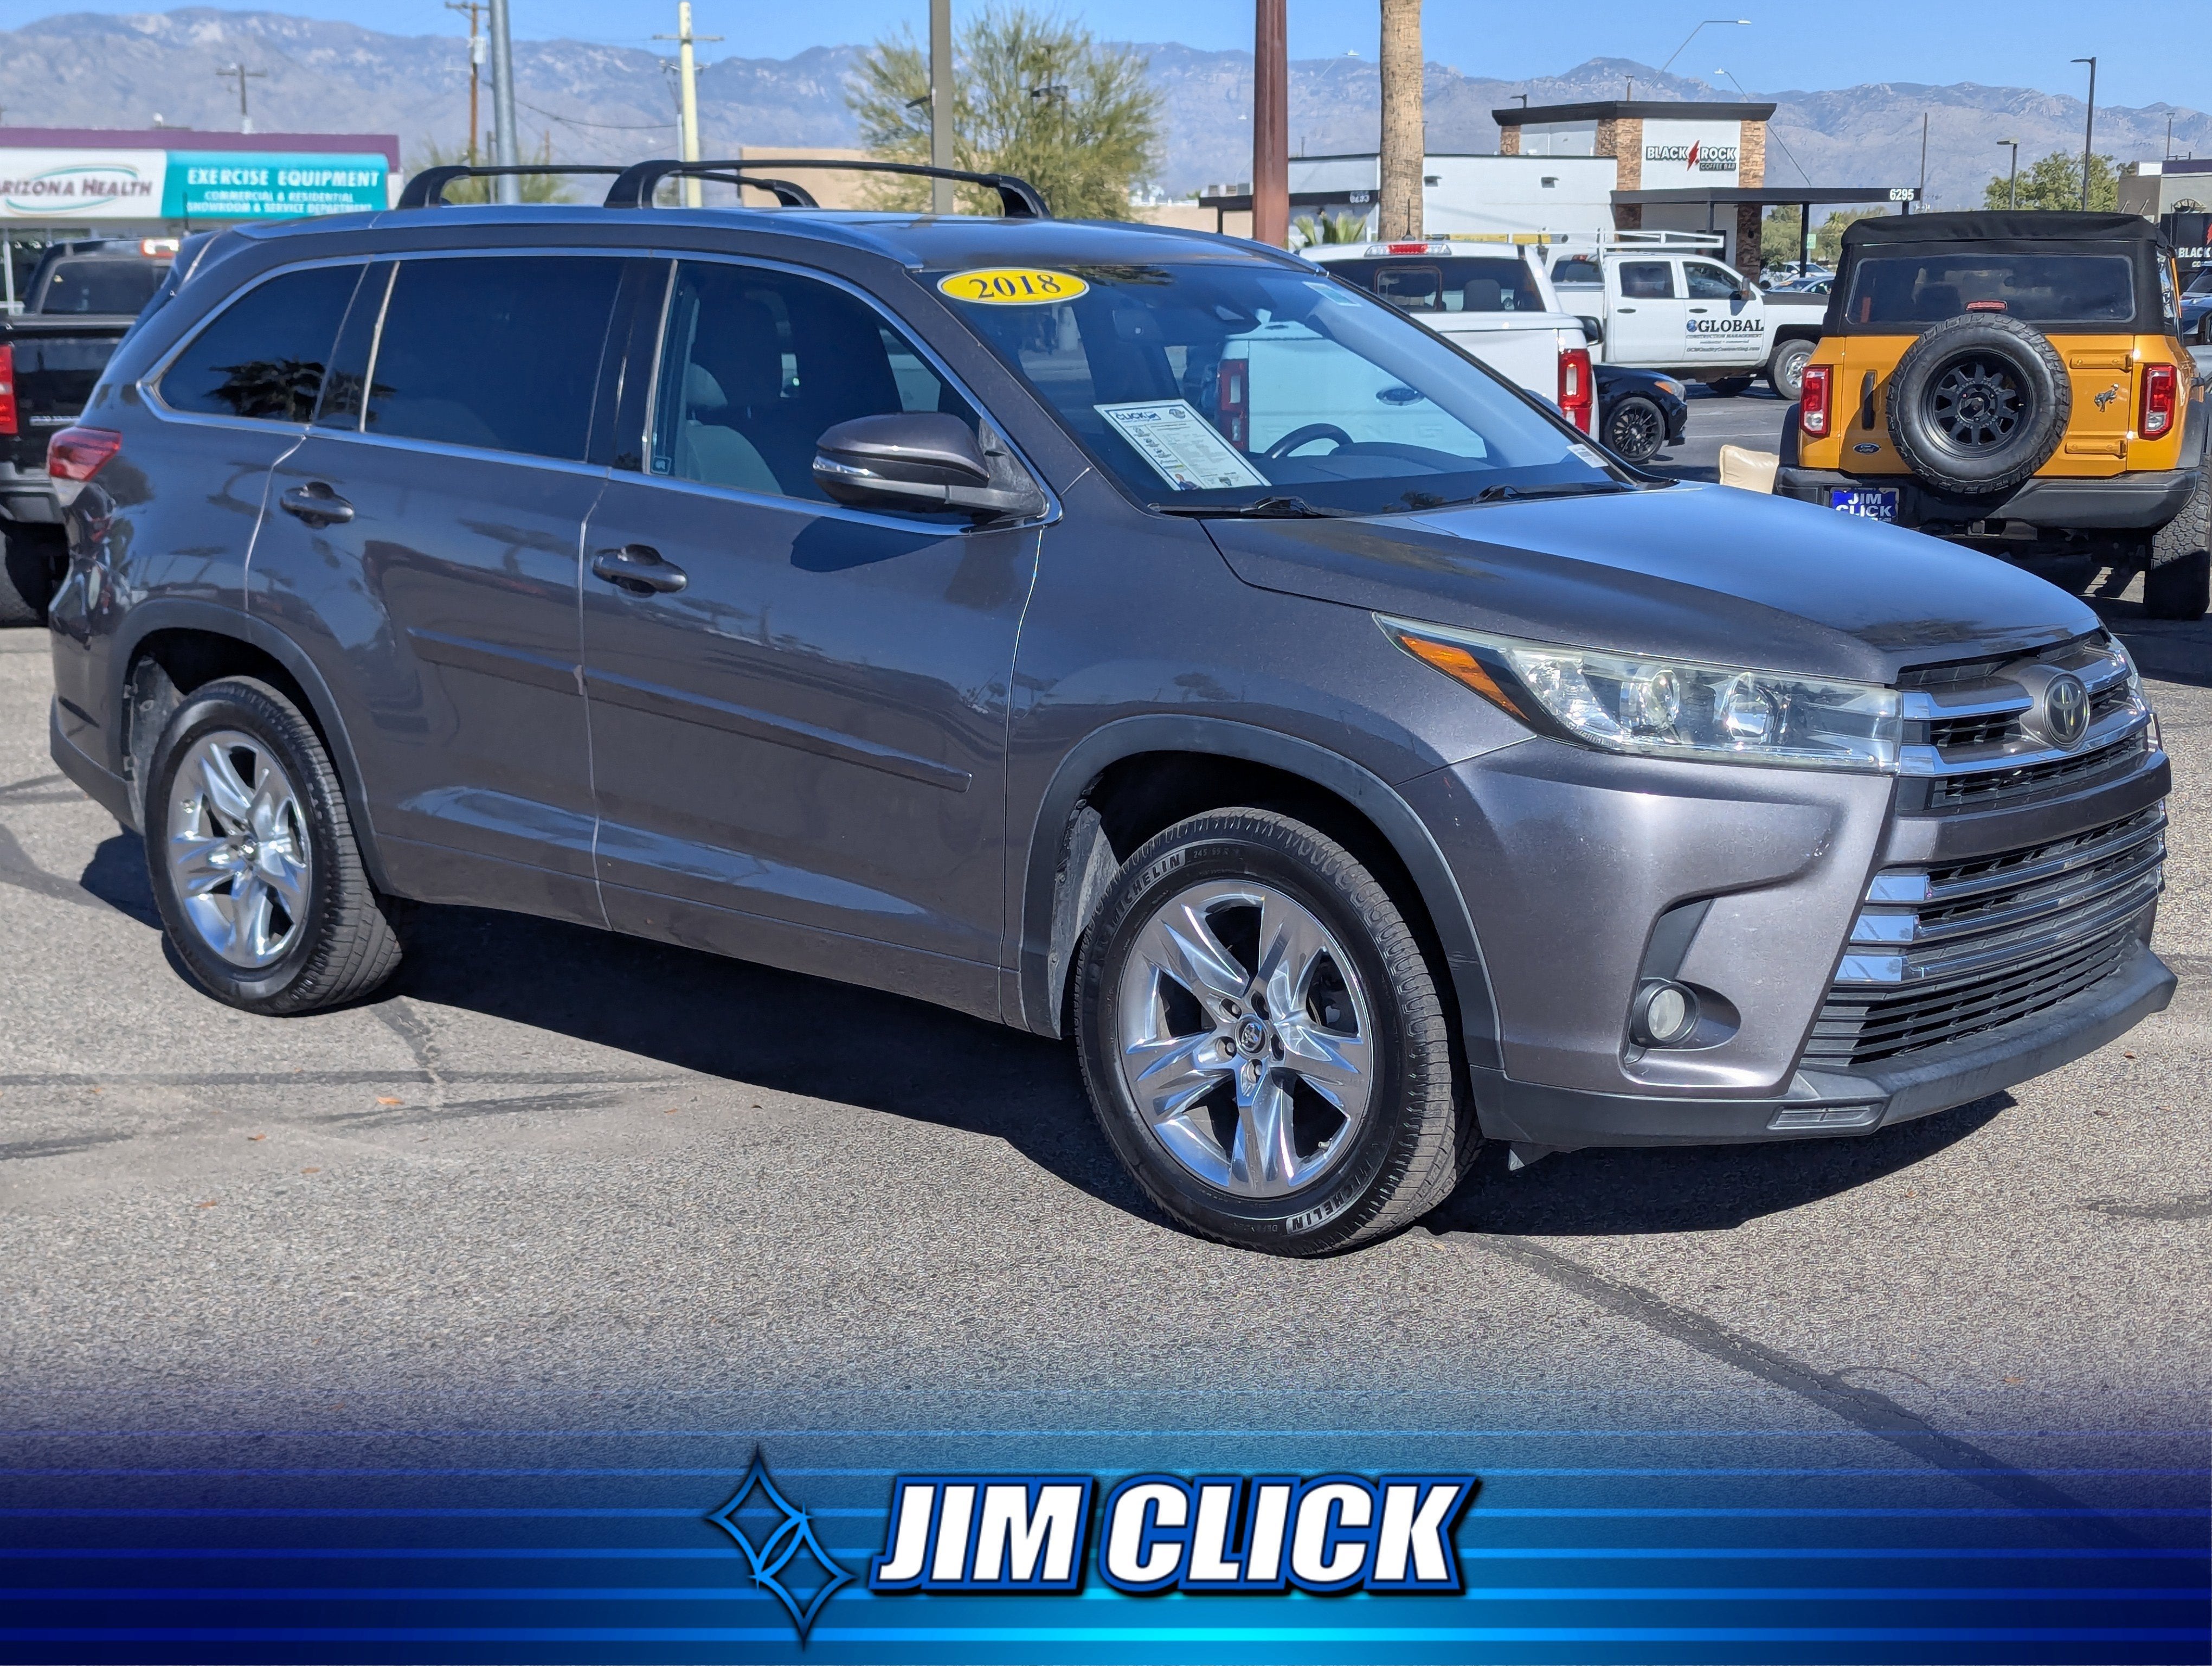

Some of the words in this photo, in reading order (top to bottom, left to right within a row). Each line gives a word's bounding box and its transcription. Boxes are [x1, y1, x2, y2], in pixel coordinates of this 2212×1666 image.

[1647, 146, 1687, 161] BLACK
[1700, 147, 1736, 161] ROCK
[187, 168, 269, 185] EXERCISE
[278, 170, 380, 187] EQUIPMENT
[0, 180, 75, 196] RIZONA
[1889, 188, 1914, 201] 6295
[968, 274, 1062, 300] 2018
[1698, 319, 1764, 332] GLOBAL
[1848, 492, 1882, 504] JIM
